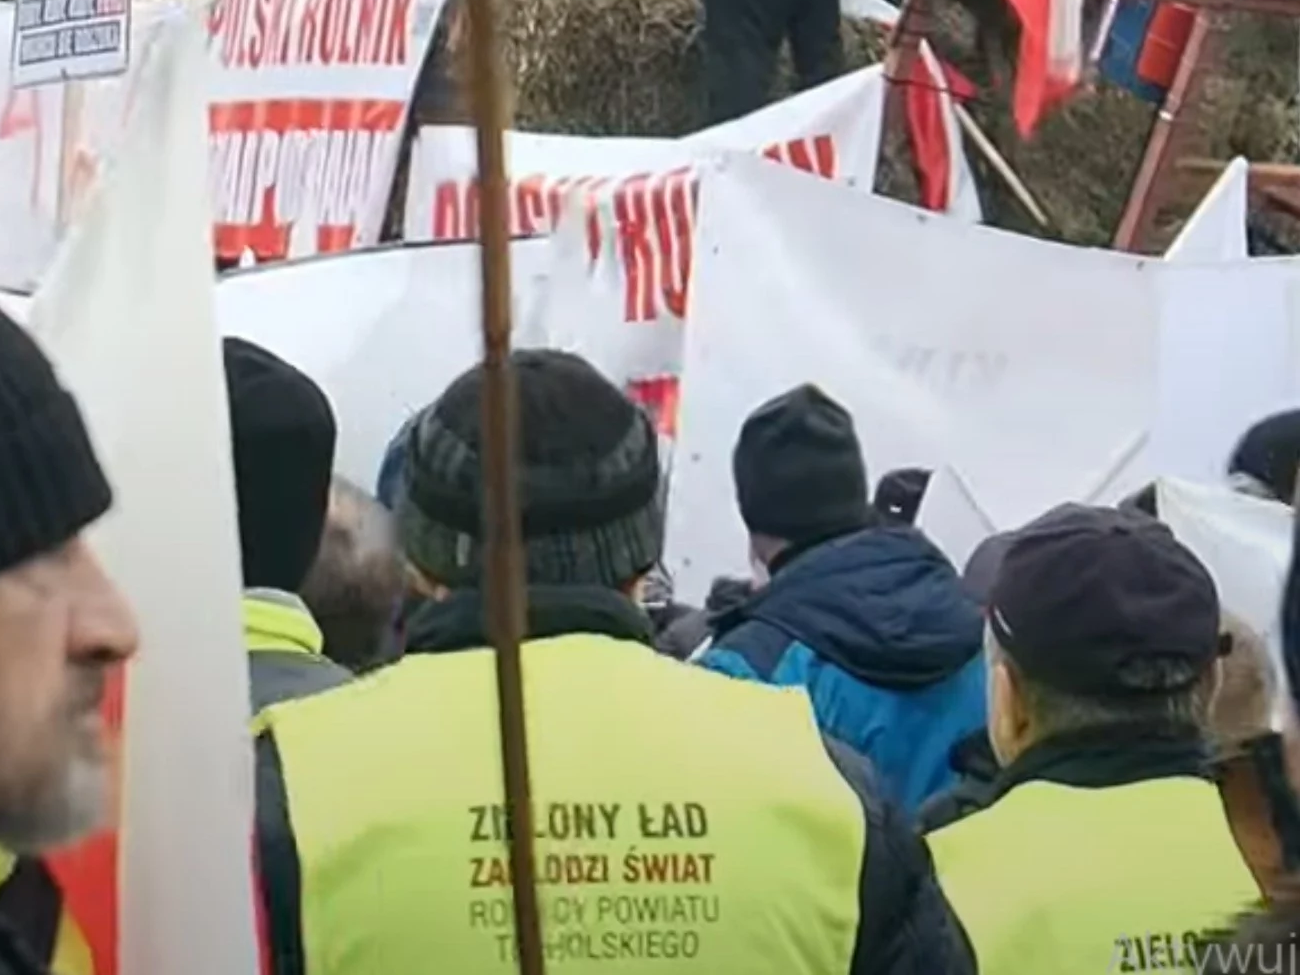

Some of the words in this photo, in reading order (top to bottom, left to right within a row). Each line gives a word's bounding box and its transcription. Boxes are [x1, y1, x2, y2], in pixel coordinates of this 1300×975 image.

[468, 802, 620, 841] ZIEONY
[638, 801, 708, 839] ŁAD
[469, 853, 609, 887] ZAODZI
[622, 845, 715, 884] ŚWIAT
[469, 895, 587, 929] ROCY
[598, 894, 720, 925] POWIATU
[495, 929, 699, 963] THOLSKIEGO
